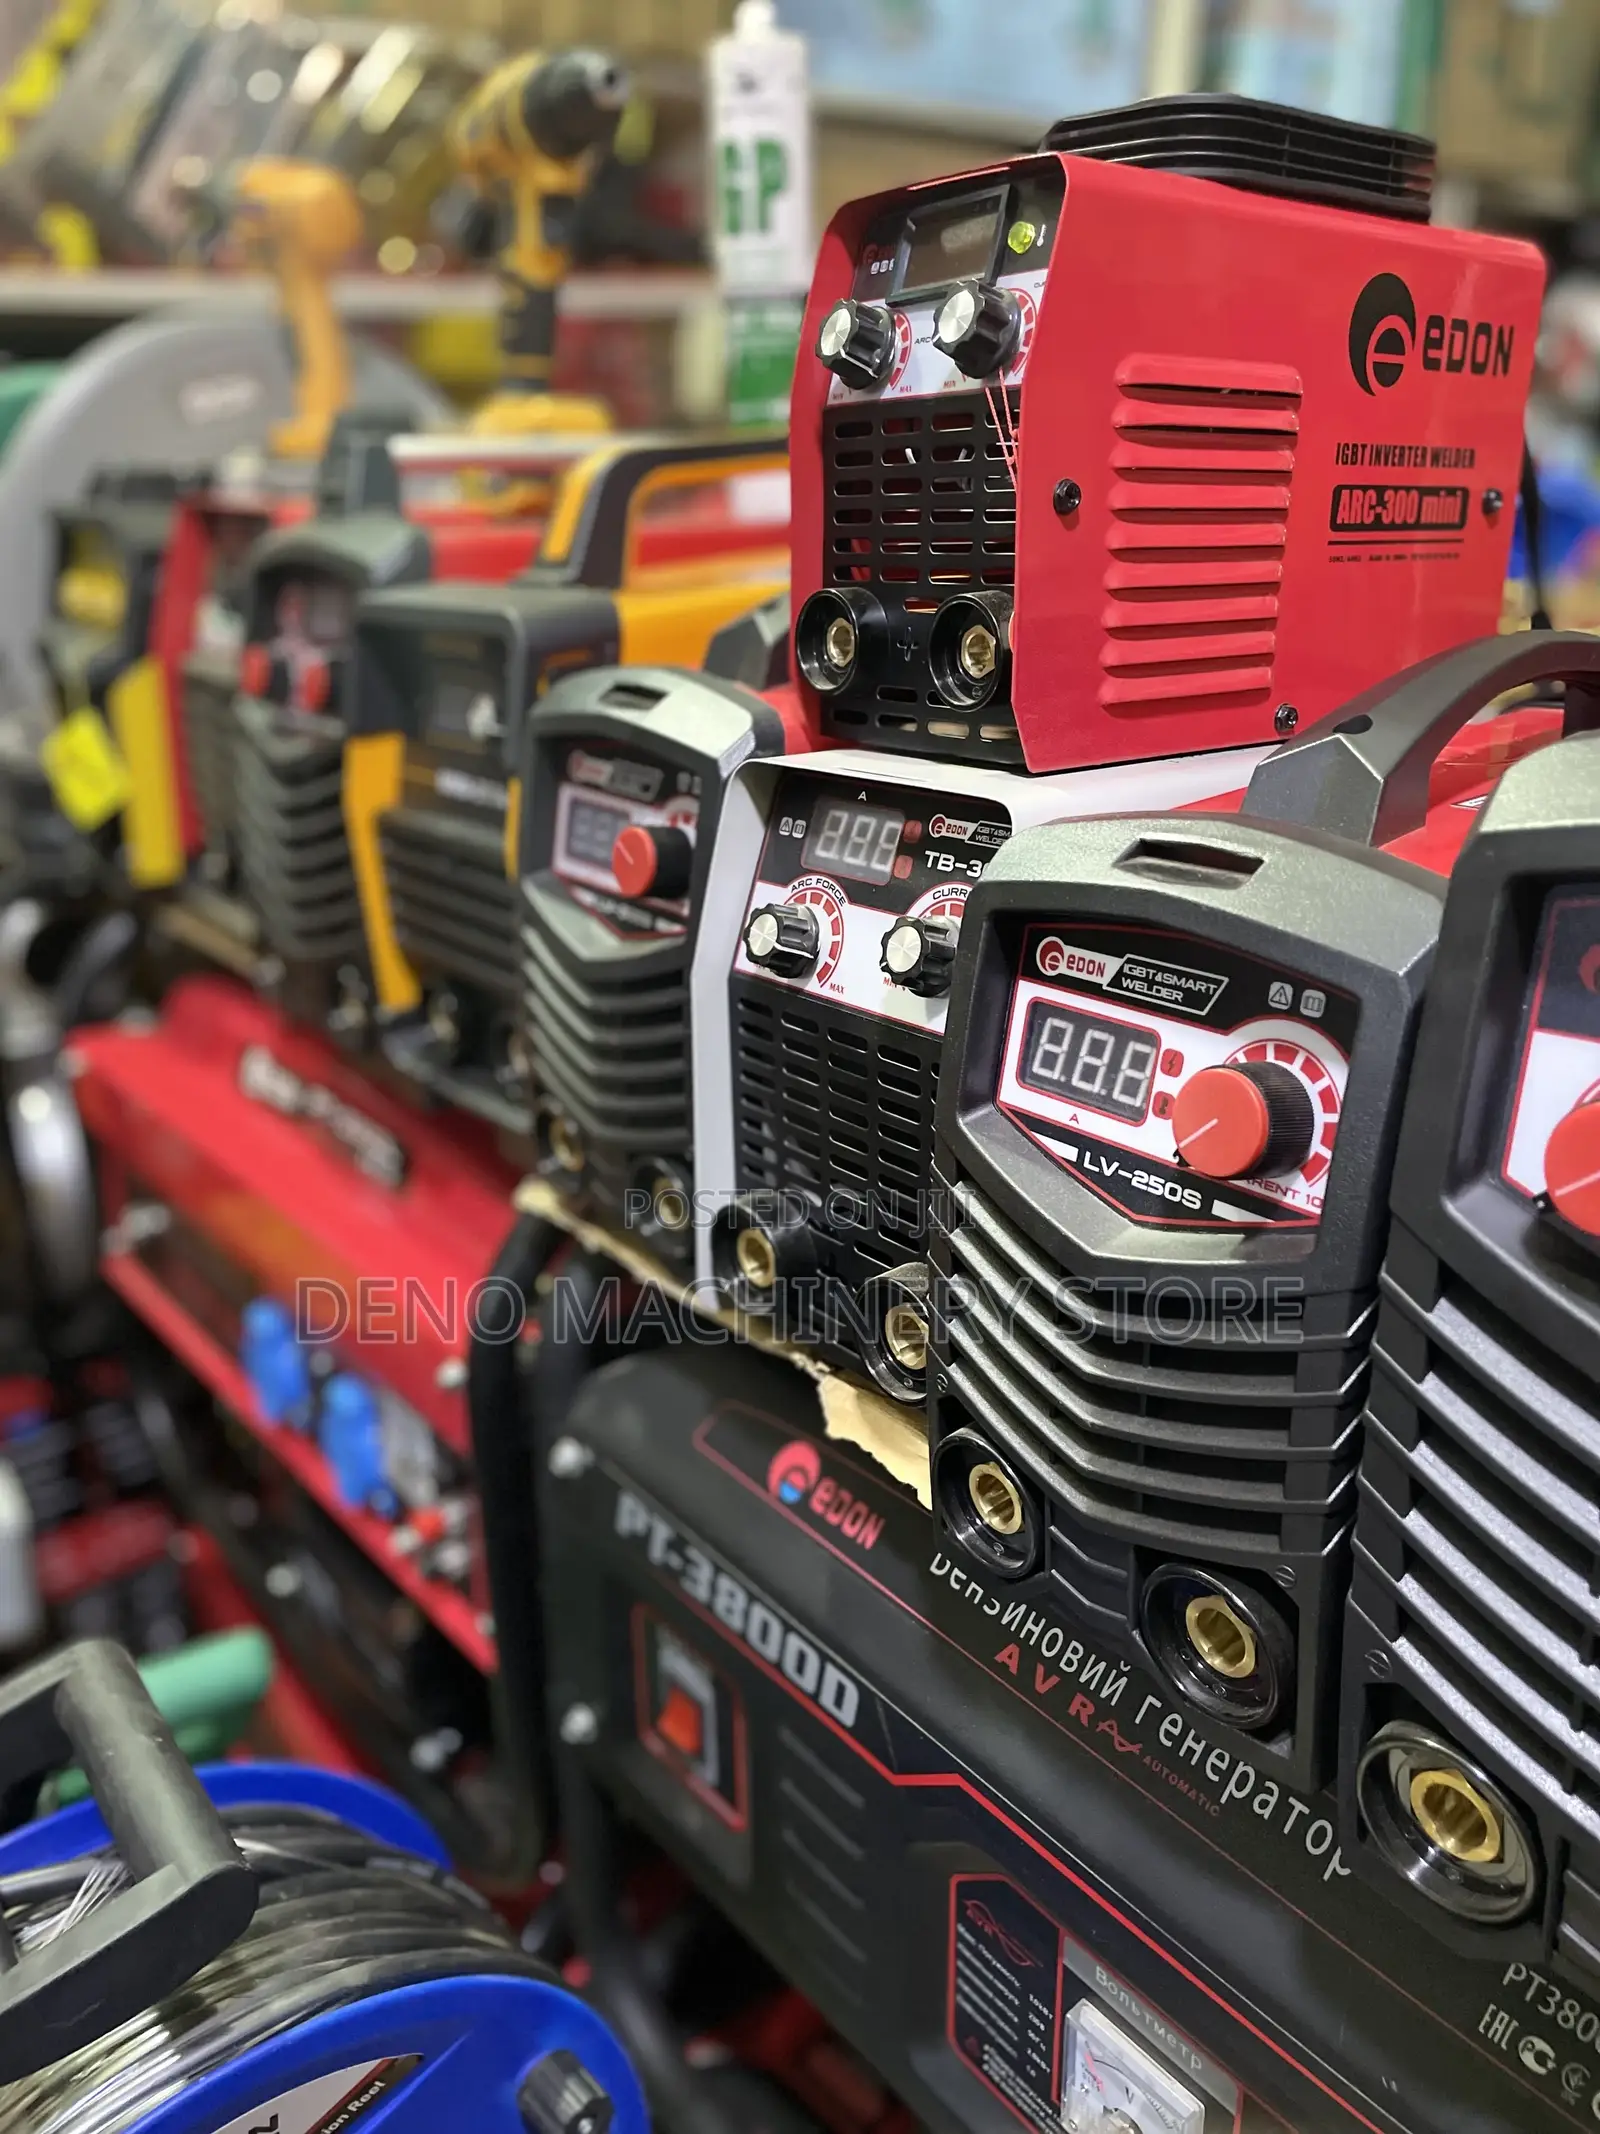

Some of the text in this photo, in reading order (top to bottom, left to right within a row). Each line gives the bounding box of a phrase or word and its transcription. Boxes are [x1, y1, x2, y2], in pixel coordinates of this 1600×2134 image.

[1335, 442, 1476, 469] IGBT INVERTER WELDER
[1335, 488, 1463, 525] ARC-300 mini
[857, 790, 867, 802] A
[790, 877, 847, 908] ARC FORCE
[828, 982, 845, 995] MAX
[1120, 975, 1184, 1003] WELDER
[1122, 962, 1218, 996] IGBT&SMART
[1068, 1112, 1080, 1126] A
[1083, 1149, 1203, 1211] LV-250S
[1142, 1755, 1221, 1818] AUTOMATIC
[1502, 1961, 1600, 2056] PT380
